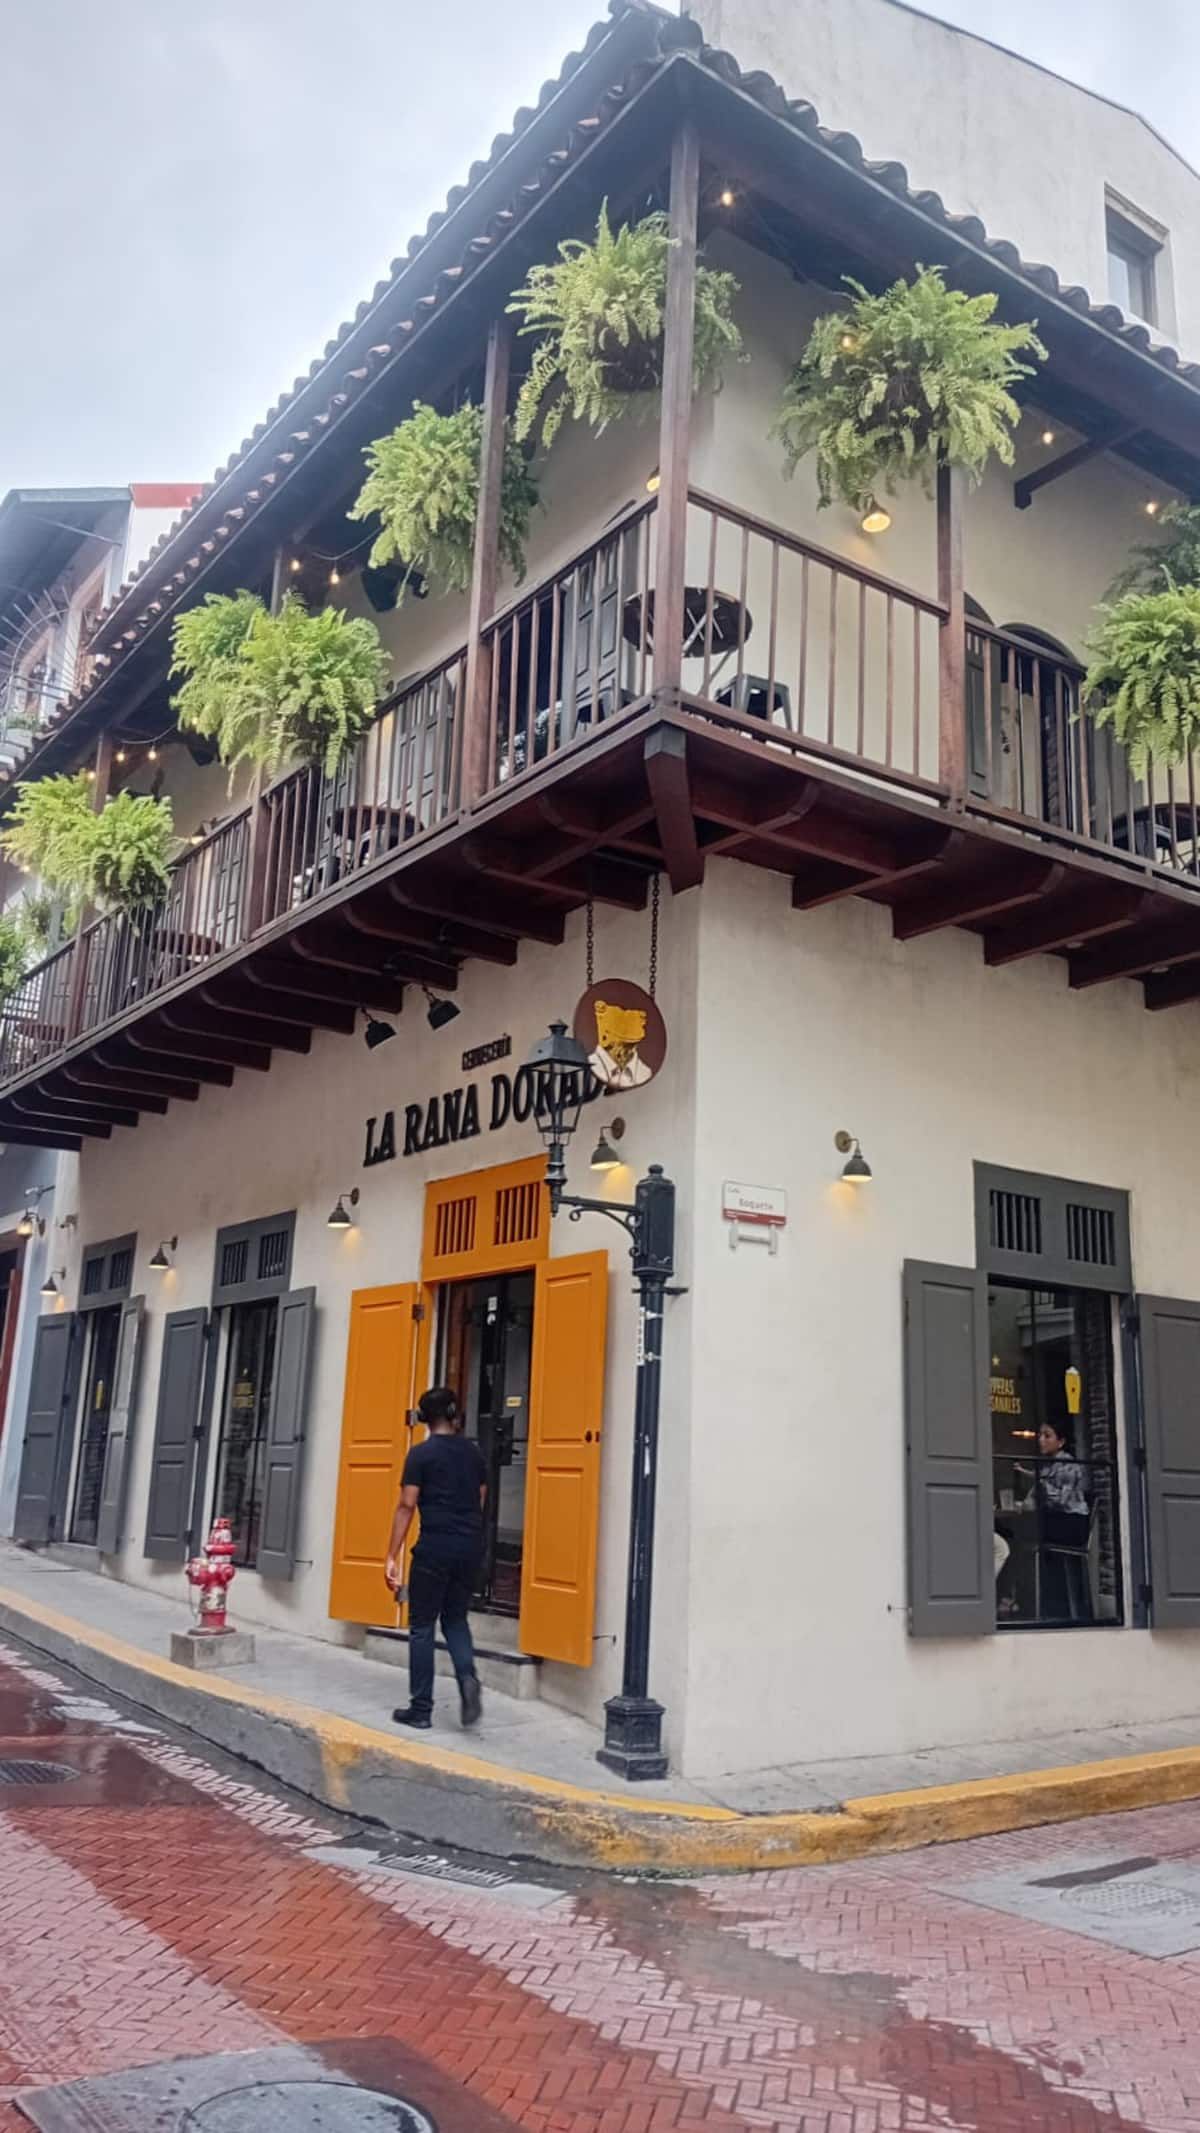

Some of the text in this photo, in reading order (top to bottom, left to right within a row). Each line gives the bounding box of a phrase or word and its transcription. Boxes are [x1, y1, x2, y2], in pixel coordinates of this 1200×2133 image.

[363, 1066, 628, 1168] LA RANA DORAD
